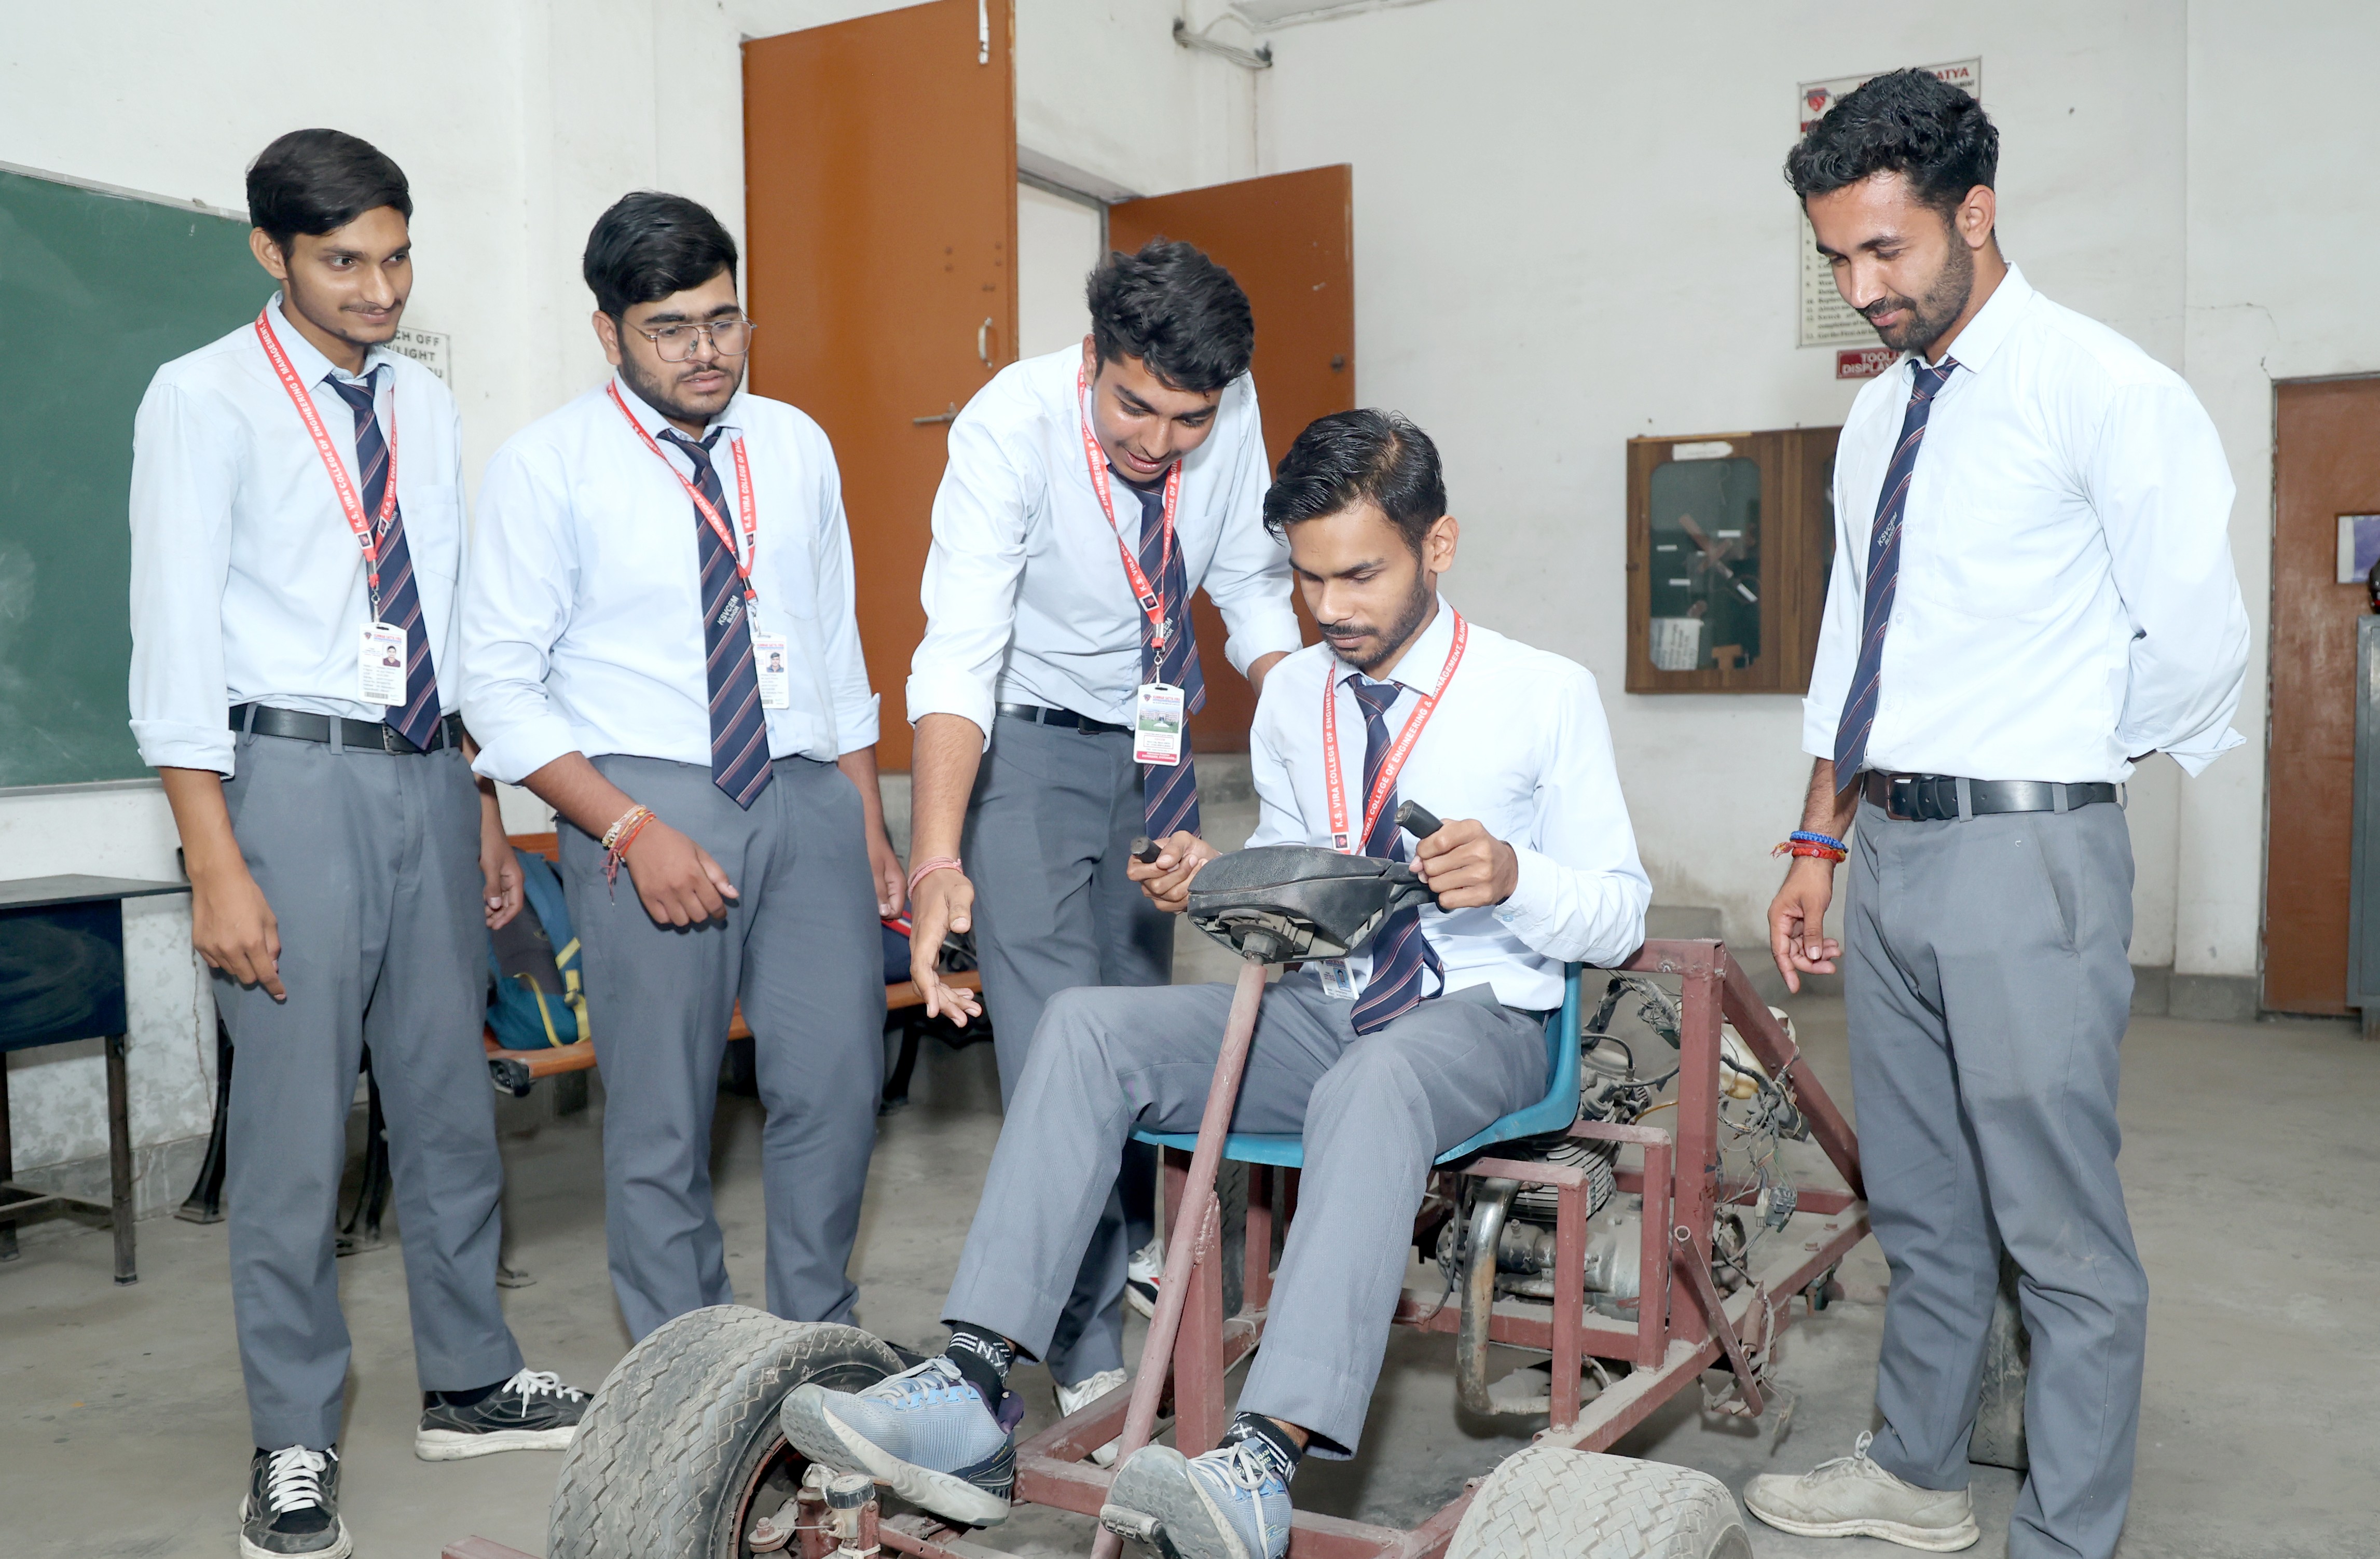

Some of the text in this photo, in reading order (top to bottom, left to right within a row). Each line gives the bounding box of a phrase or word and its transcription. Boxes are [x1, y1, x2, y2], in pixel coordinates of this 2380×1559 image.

[1937, 66, 1969, 80] ATYA
[416, 334, 439, 346] OFF
[290, 382, 324, 437] ENGINEERING
[318, 438, 329, 450] OF
[324, 451, 347, 489] COLLEGE
[736, 454, 745, 463] OF
[738, 464, 750, 494] COLLEGE
[1090, 449, 1109, 507] ENGINEERING
[341, 490, 356, 511] VIRA
[1169, 485, 1176, 496] OF
[741, 495, 751, 513] VIRA
[1166, 498, 1175, 534] COLLEGE
[1877, 511, 1897, 547] KSVCEM
[1127, 558, 1138, 575] VIRA
[717, 595, 739, 626] KSVCEM
[726, 605, 740, 624] BIJNOR
[1325, 671, 1333, 730] ENGINEERING
[1326, 731, 1333, 743] OF
[1327, 744, 1338, 785] COLLEGE
[1363, 817, 1373, 837] VIRA
[1369, 776, 1390, 816] COLLEGE
[1385, 763, 1396, 776] OF
[1392, 708, 1428, 764] ENGINEERING
[1423, 700, 1433, 708] &
[1331, 786, 1340, 809] VIRA
